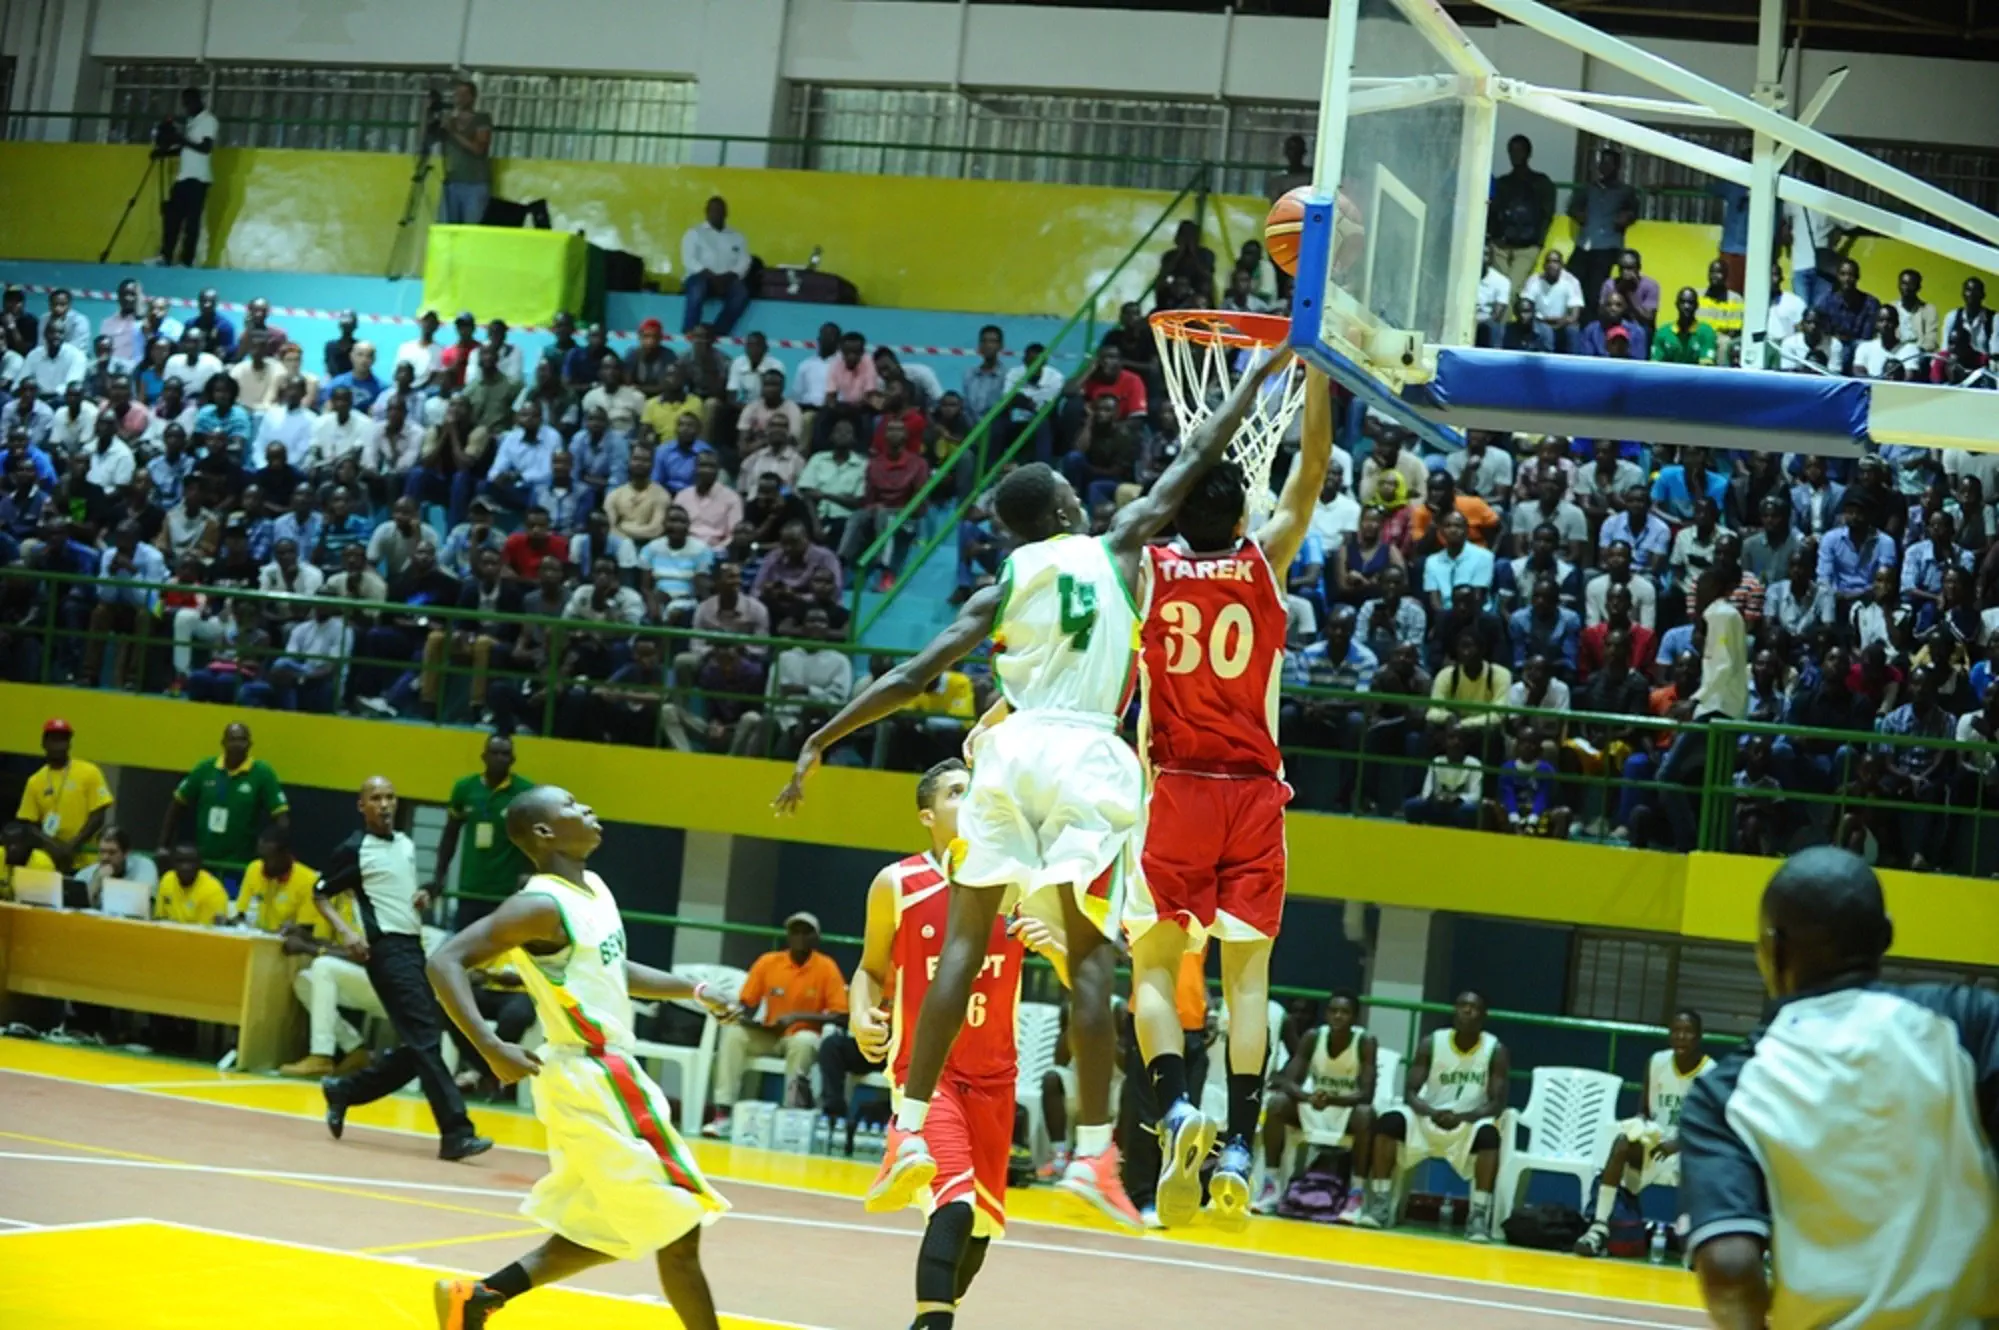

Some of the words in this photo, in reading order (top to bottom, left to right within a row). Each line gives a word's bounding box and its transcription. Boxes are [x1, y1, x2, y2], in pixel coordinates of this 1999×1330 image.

[1158, 558, 1254, 583] TAREK
[1160, 600, 1254, 680] 30
[925, 953, 1006, 981] EPT
